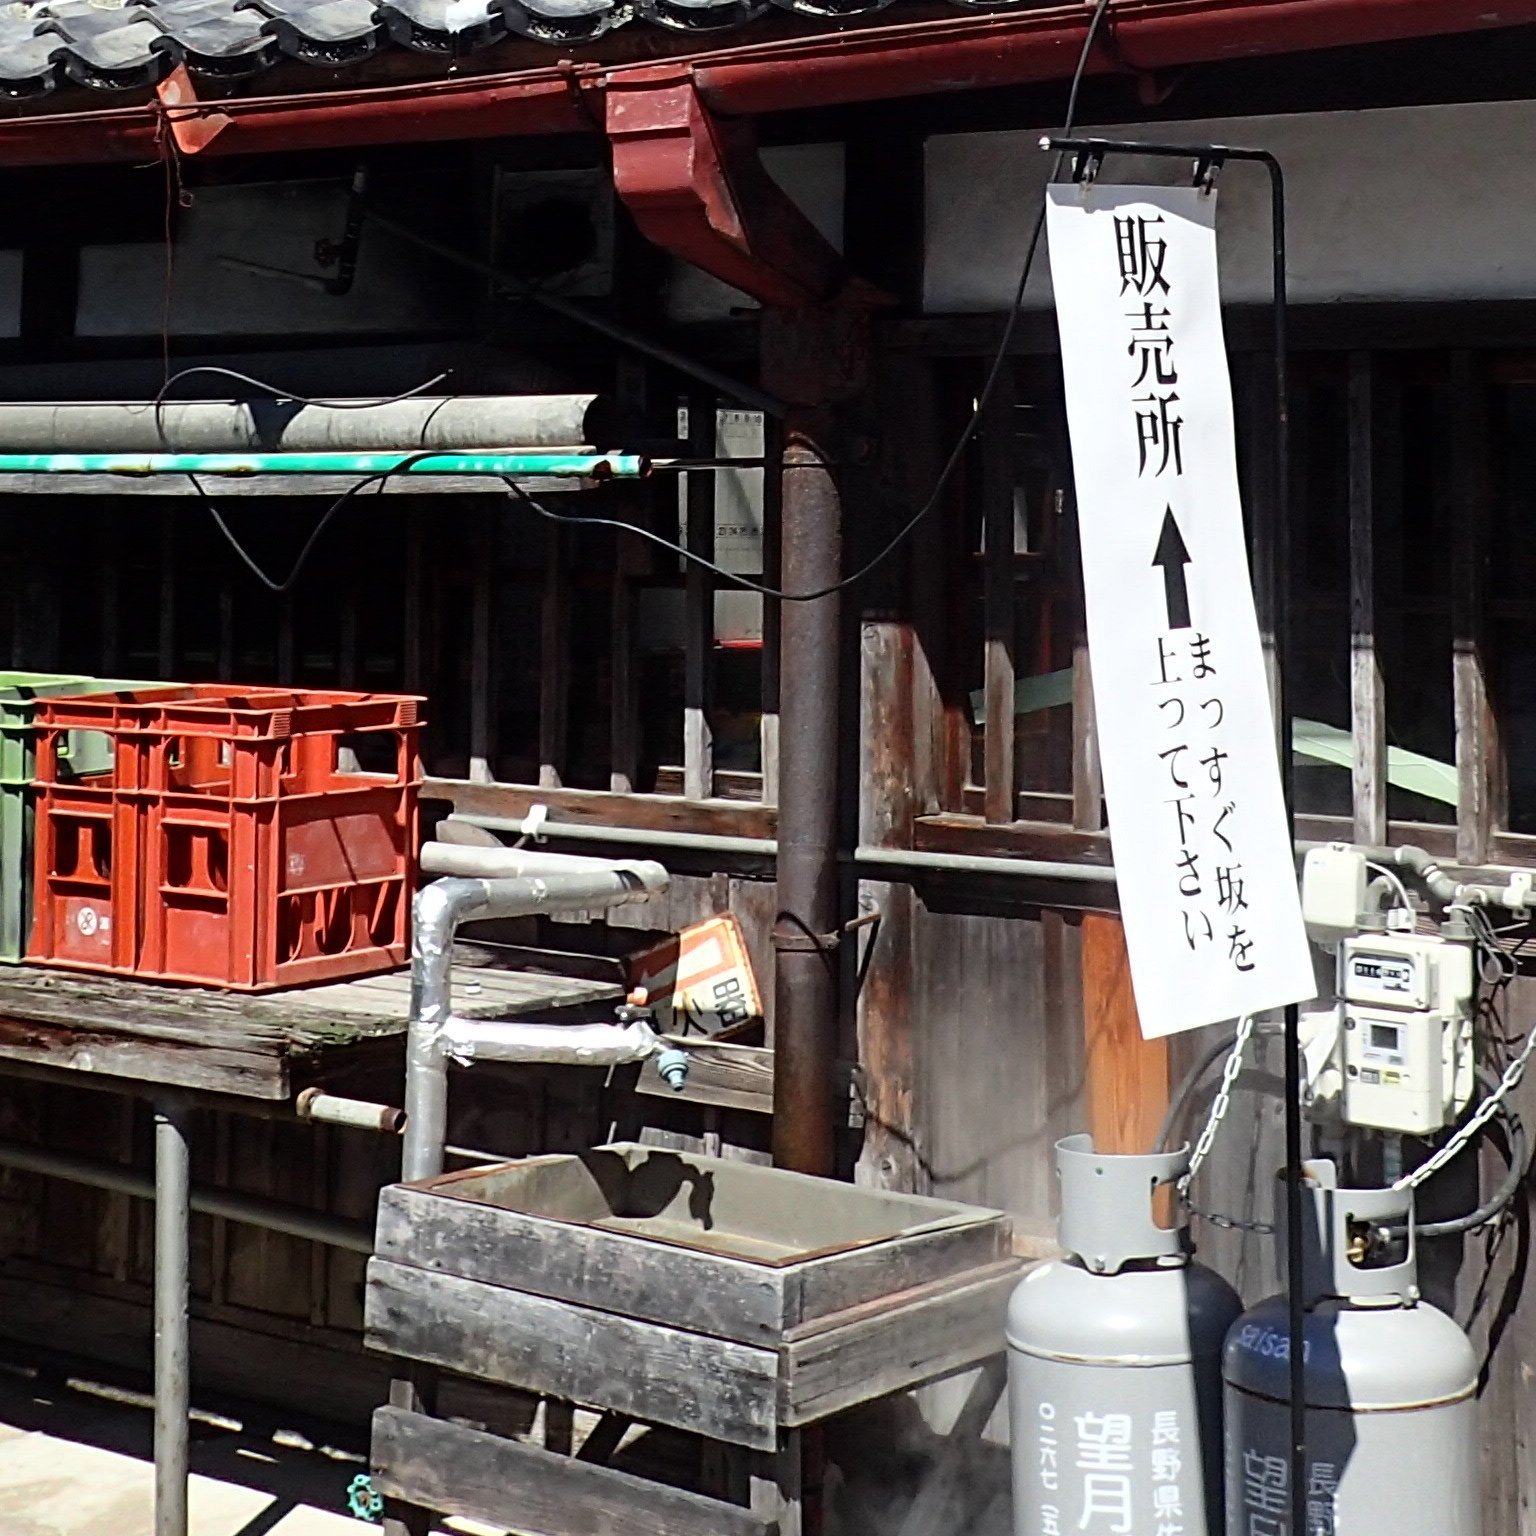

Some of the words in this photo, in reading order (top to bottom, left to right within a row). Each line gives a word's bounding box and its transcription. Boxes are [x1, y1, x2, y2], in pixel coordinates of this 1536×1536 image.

[1113, 214, 1186, 480] 販売所
[1149, 636, 1216, 950] 上って下さい
[1188, 632, 1256, 972] まっすぐ坂を
